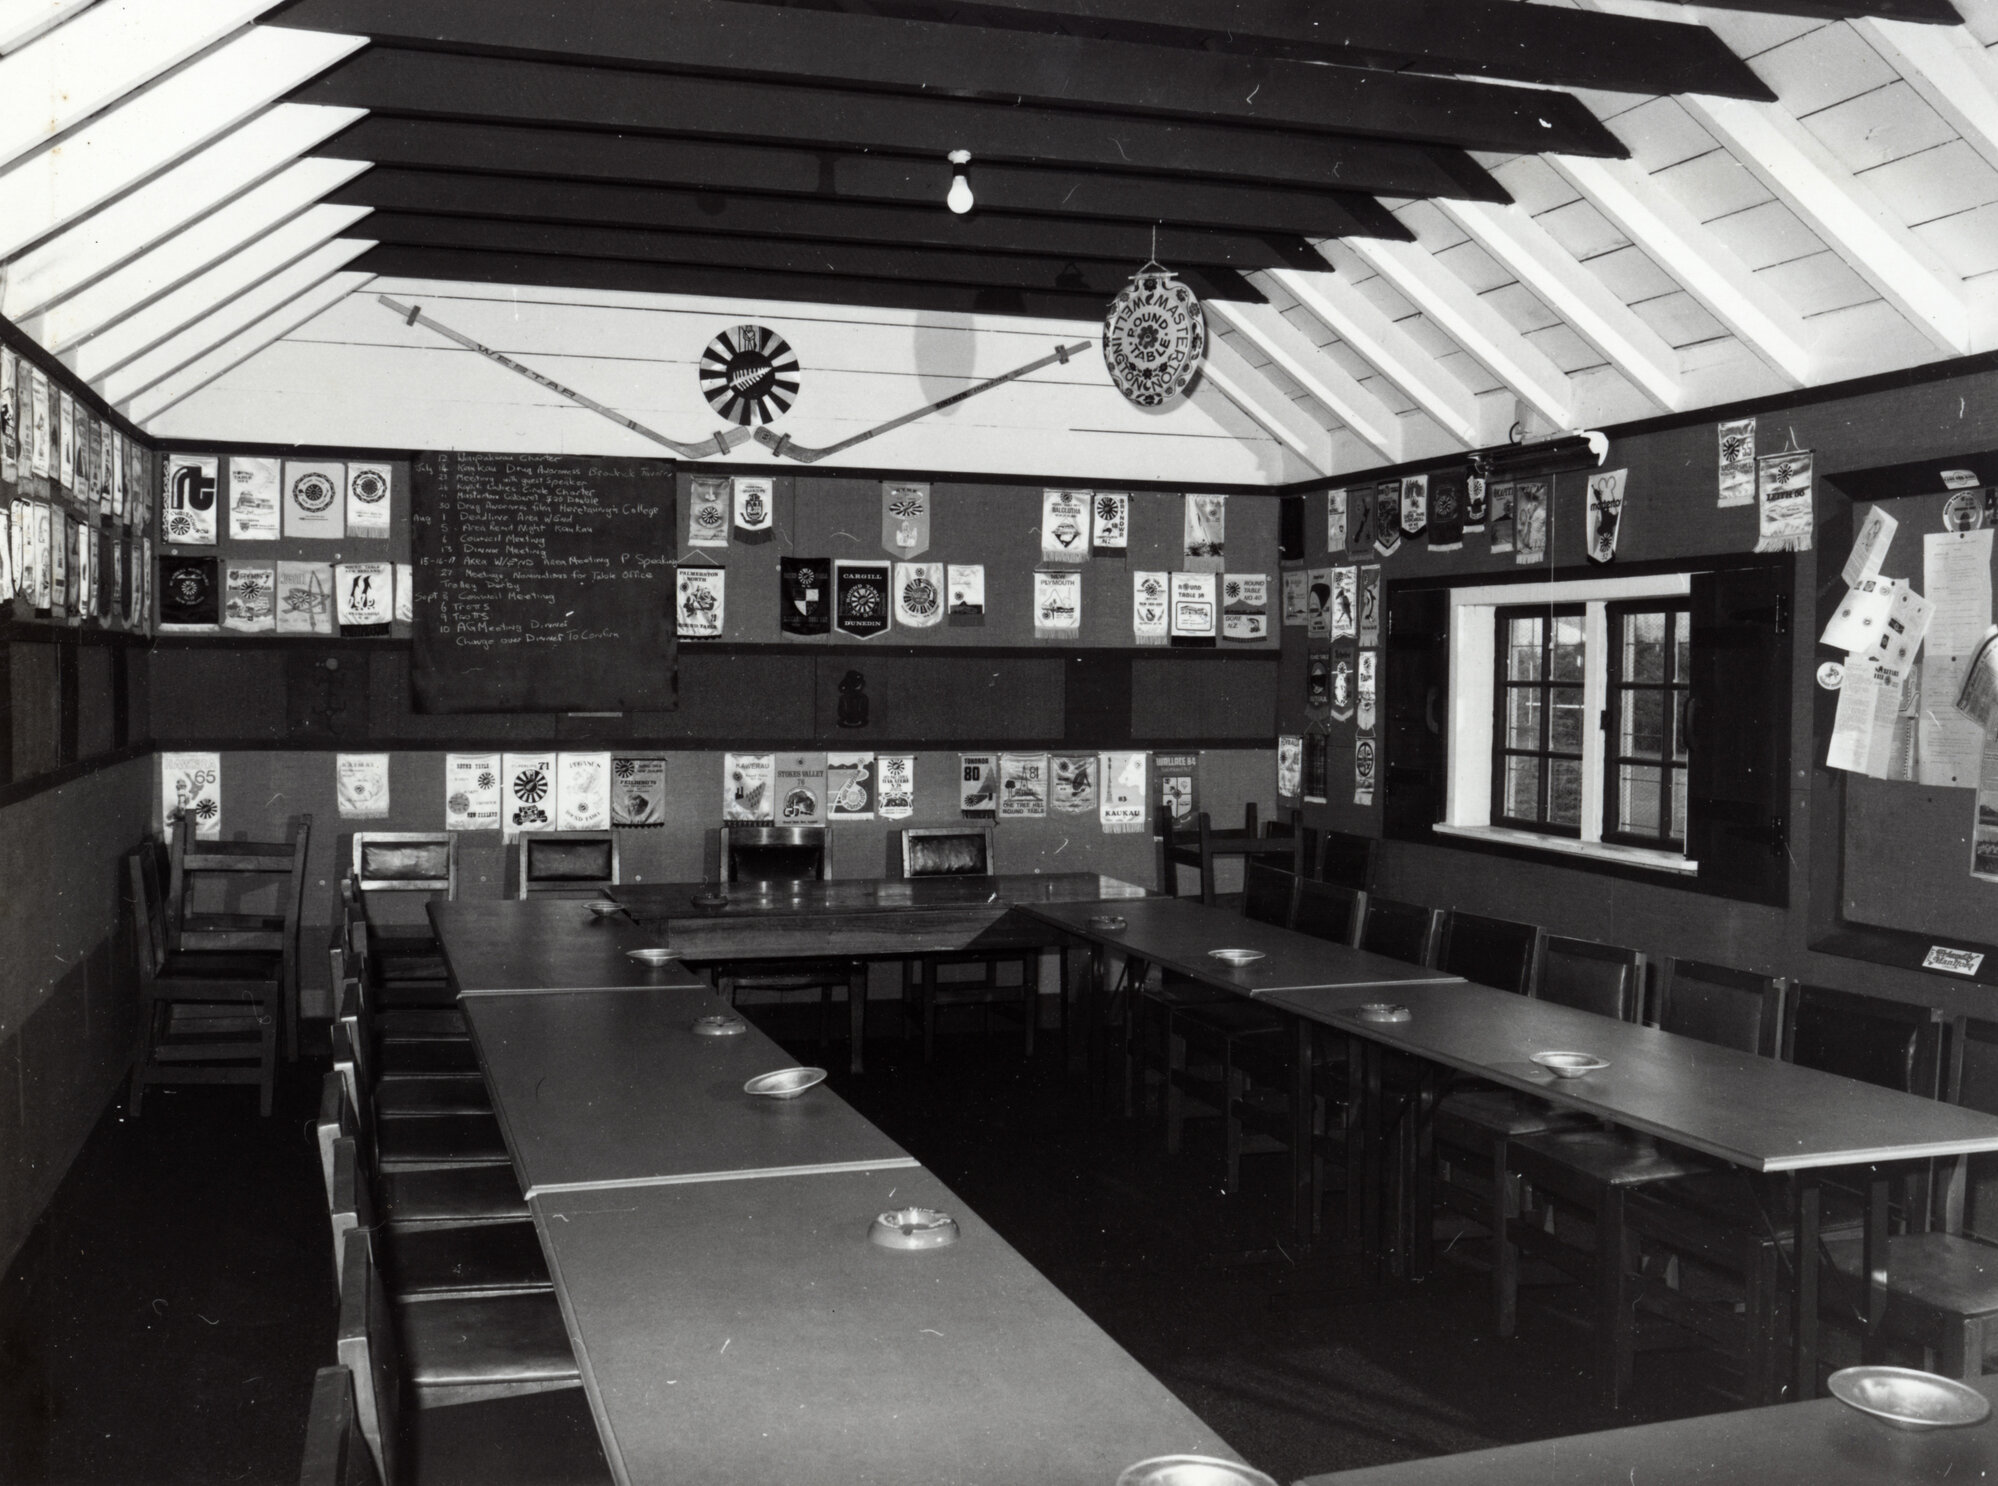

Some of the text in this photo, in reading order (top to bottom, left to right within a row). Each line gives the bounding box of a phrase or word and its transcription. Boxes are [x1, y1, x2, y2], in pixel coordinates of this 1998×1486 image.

[1127, 312, 1168, 338] ROUND
[1112, 297, 1146, 391] WELLINGTON
[1130, 337, 1170, 362] TABLE
[1151, 294, 1189, 392] MASTERTON
[506, 464, 532, 475] Drug
[546, 477, 588, 488] Speaker
[556, 487, 596, 496] Charter
[1766, 490, 1792, 502] LEITH
[457, 501, 482, 513] Drug
[622, 504, 659, 519] College
[413, 514, 432, 525] Aug
[460, 512, 509, 521] Deadline
[518, 524, 547, 535] Night
[506, 534, 545, 549] Meeting
[505, 545, 547, 559] Meeting
[464, 556, 488, 565] Area
[568, 555, 610, 567] Meeting
[635, 553, 677, 569] Speaking
[571, 570, 586, 579] for
[622, 570, 653, 579] Office
[508, 591, 555, 605] Meeting
[456, 636, 496, 650] Change
[538, 762, 550, 770] 71
[1029, 766, 1039, 780] 81
[195, 770, 217, 784] 65
[964, 766, 980, 781] 80
